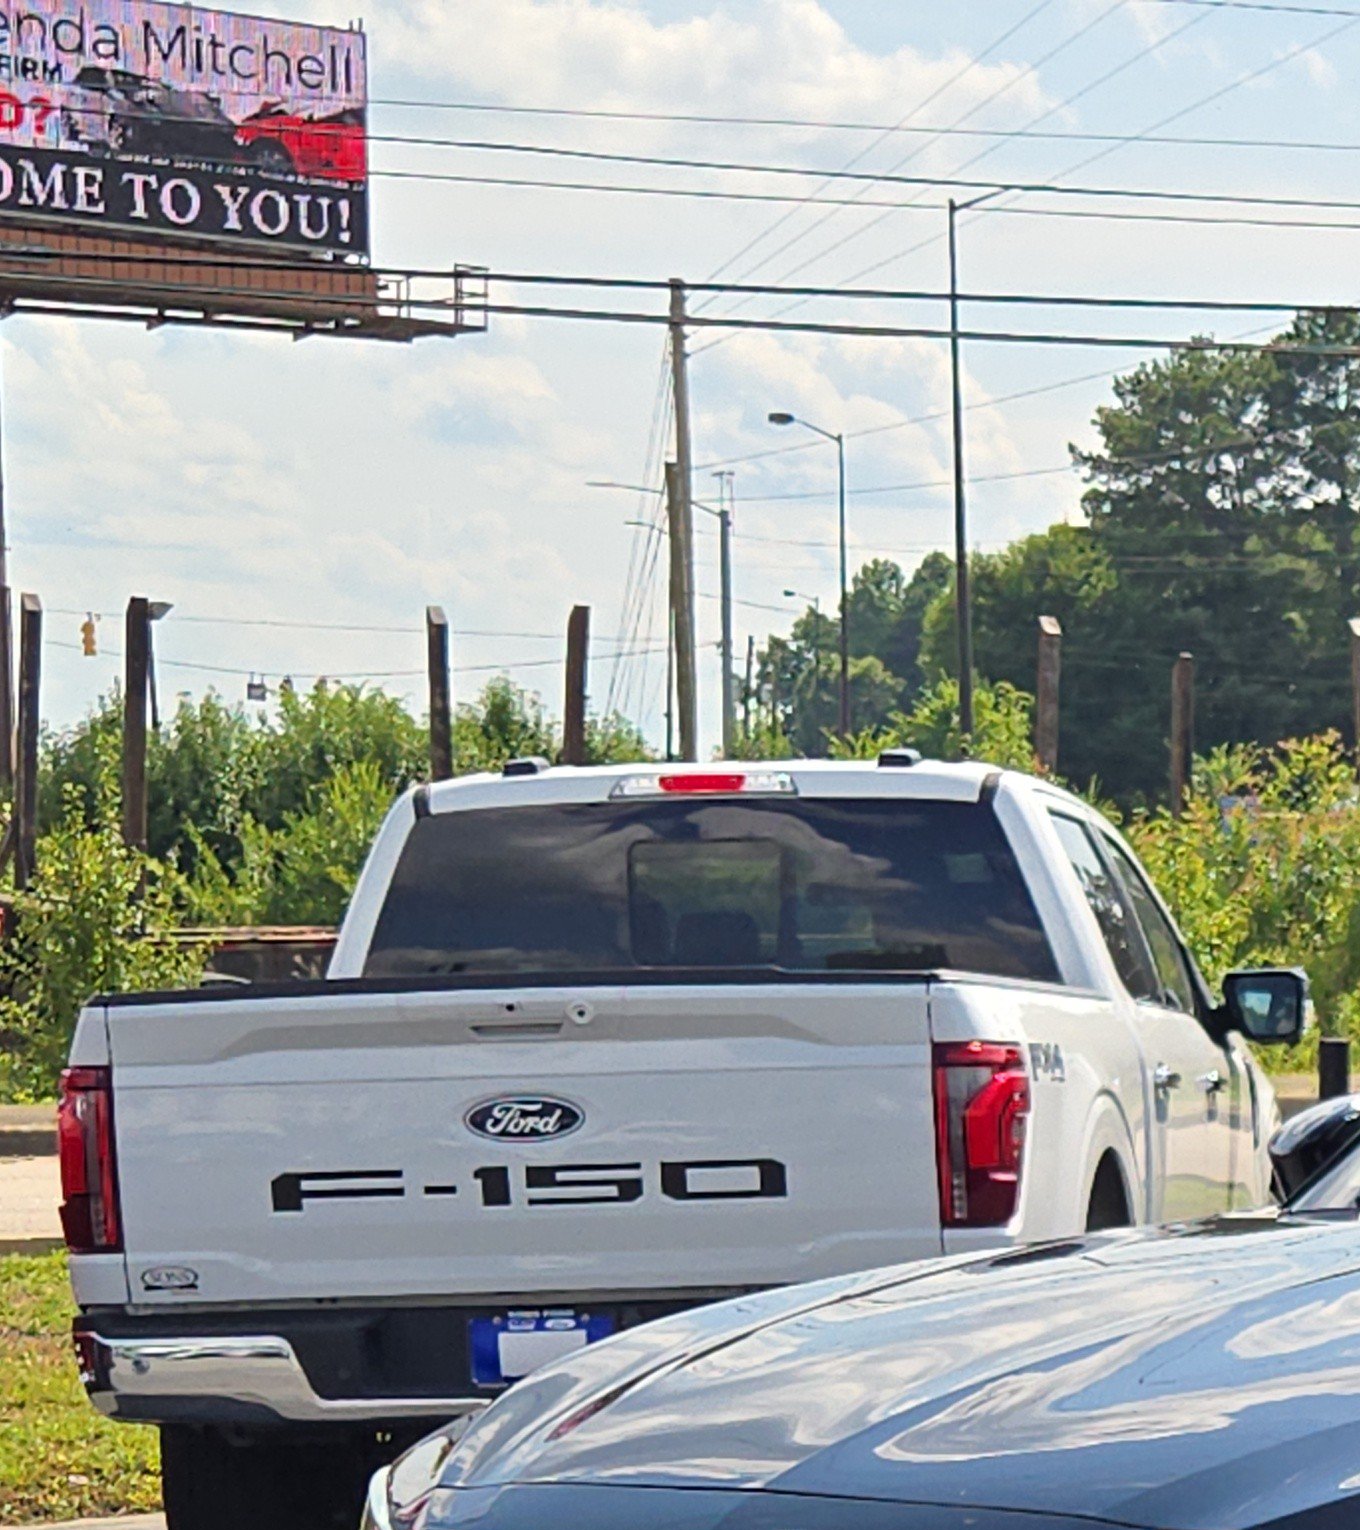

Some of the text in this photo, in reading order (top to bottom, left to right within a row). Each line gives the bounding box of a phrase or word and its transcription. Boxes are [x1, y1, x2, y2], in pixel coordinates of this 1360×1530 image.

[143, 20, 351, 93] Mitchell
[120, 172, 200, 226] TO
[213, 183, 351, 244] YOU!
[485, 1102, 562, 1134] Ford
[270, 1159, 788, 1213] F-150
